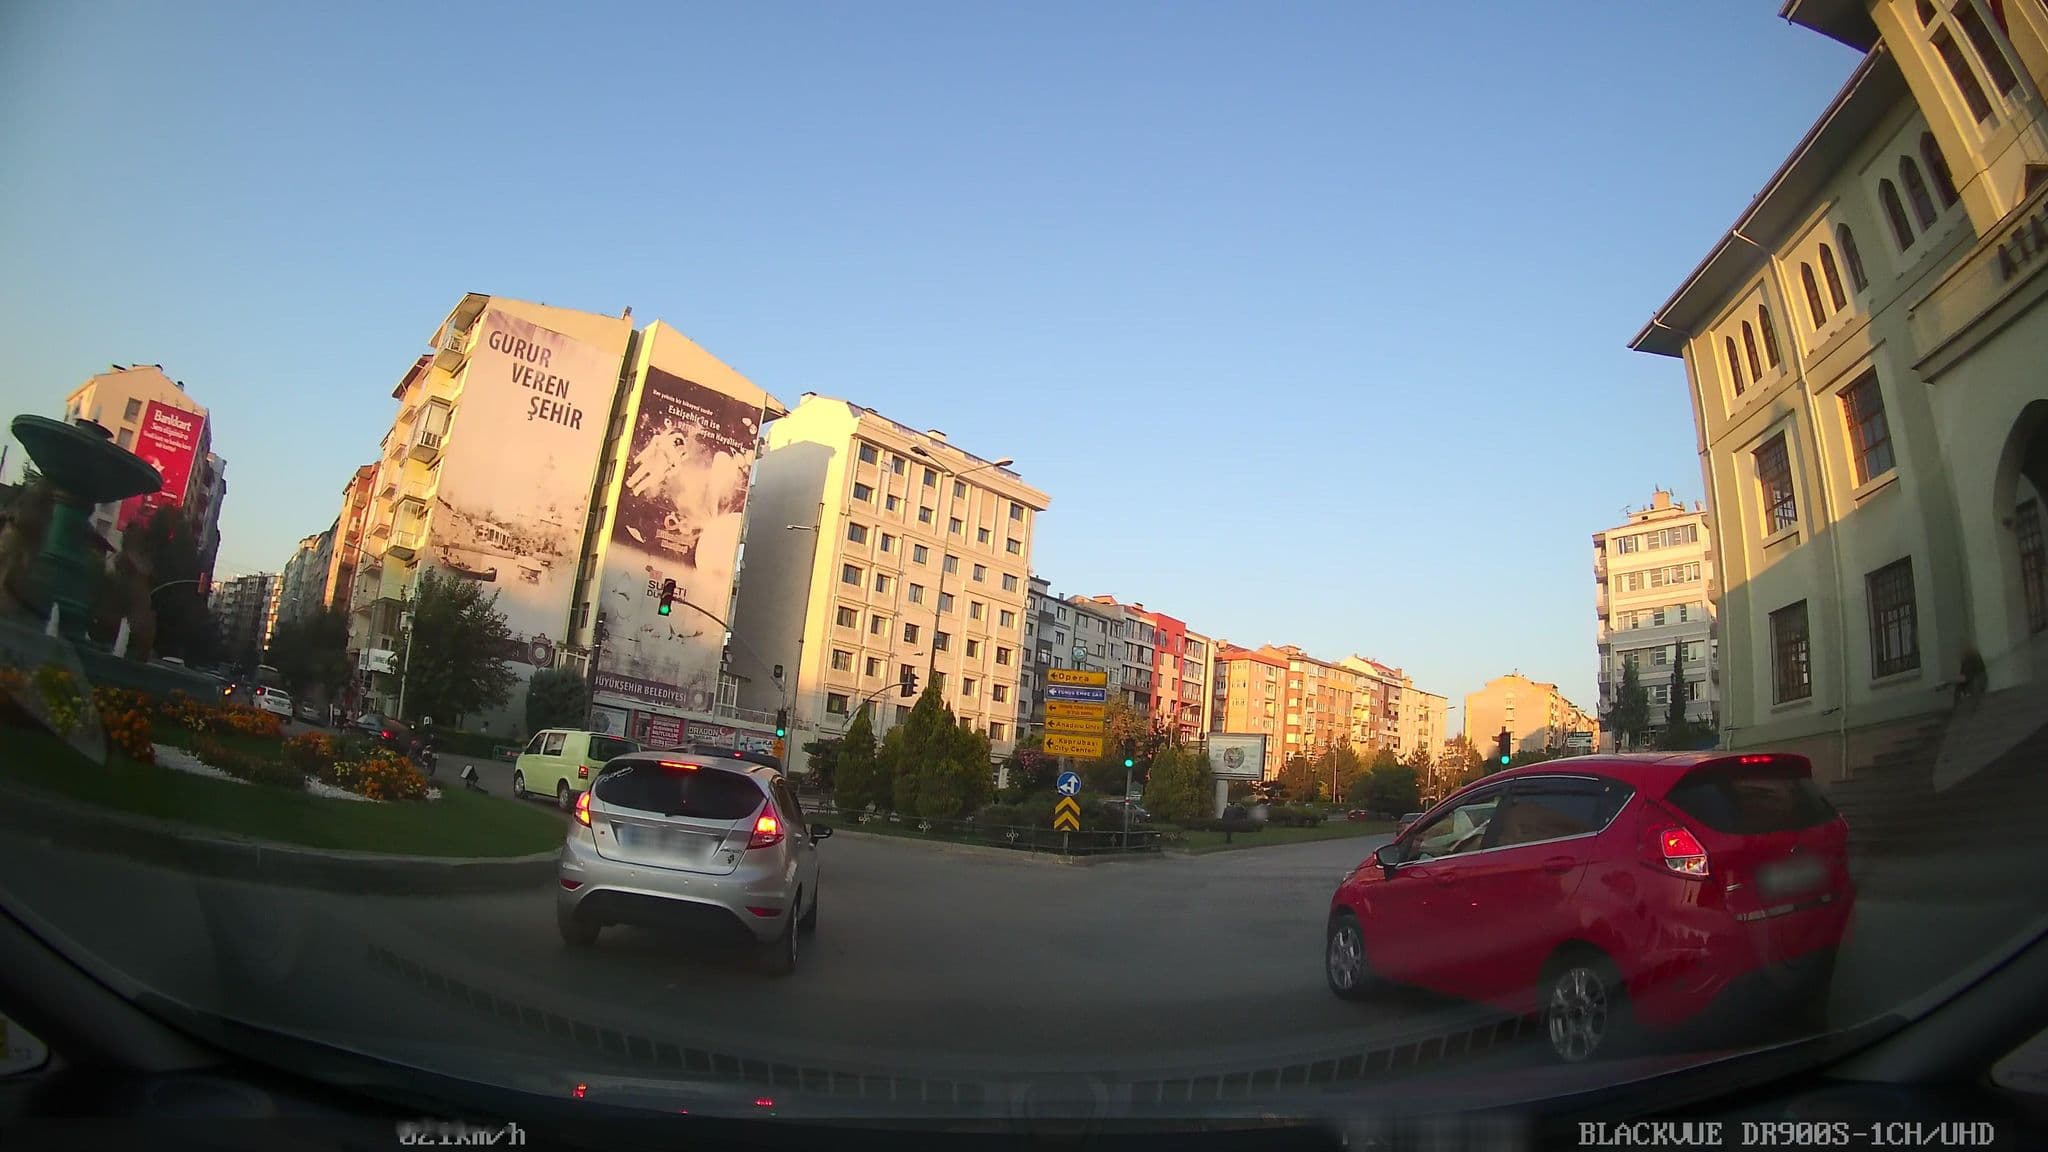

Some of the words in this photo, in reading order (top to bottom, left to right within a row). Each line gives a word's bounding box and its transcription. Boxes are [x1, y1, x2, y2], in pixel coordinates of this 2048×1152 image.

[489, 330, 552, 368] GURUR
[512, 362, 570, 399] VEREN
[154, 409, 192, 431] Bankkart
[527, 396, 583, 430] ŞEHİR
[709, 419, 720, 431] ise
[1058, 672, 1089, 682] Opera
[644, 686, 687, 702] BELEDİYESİ
